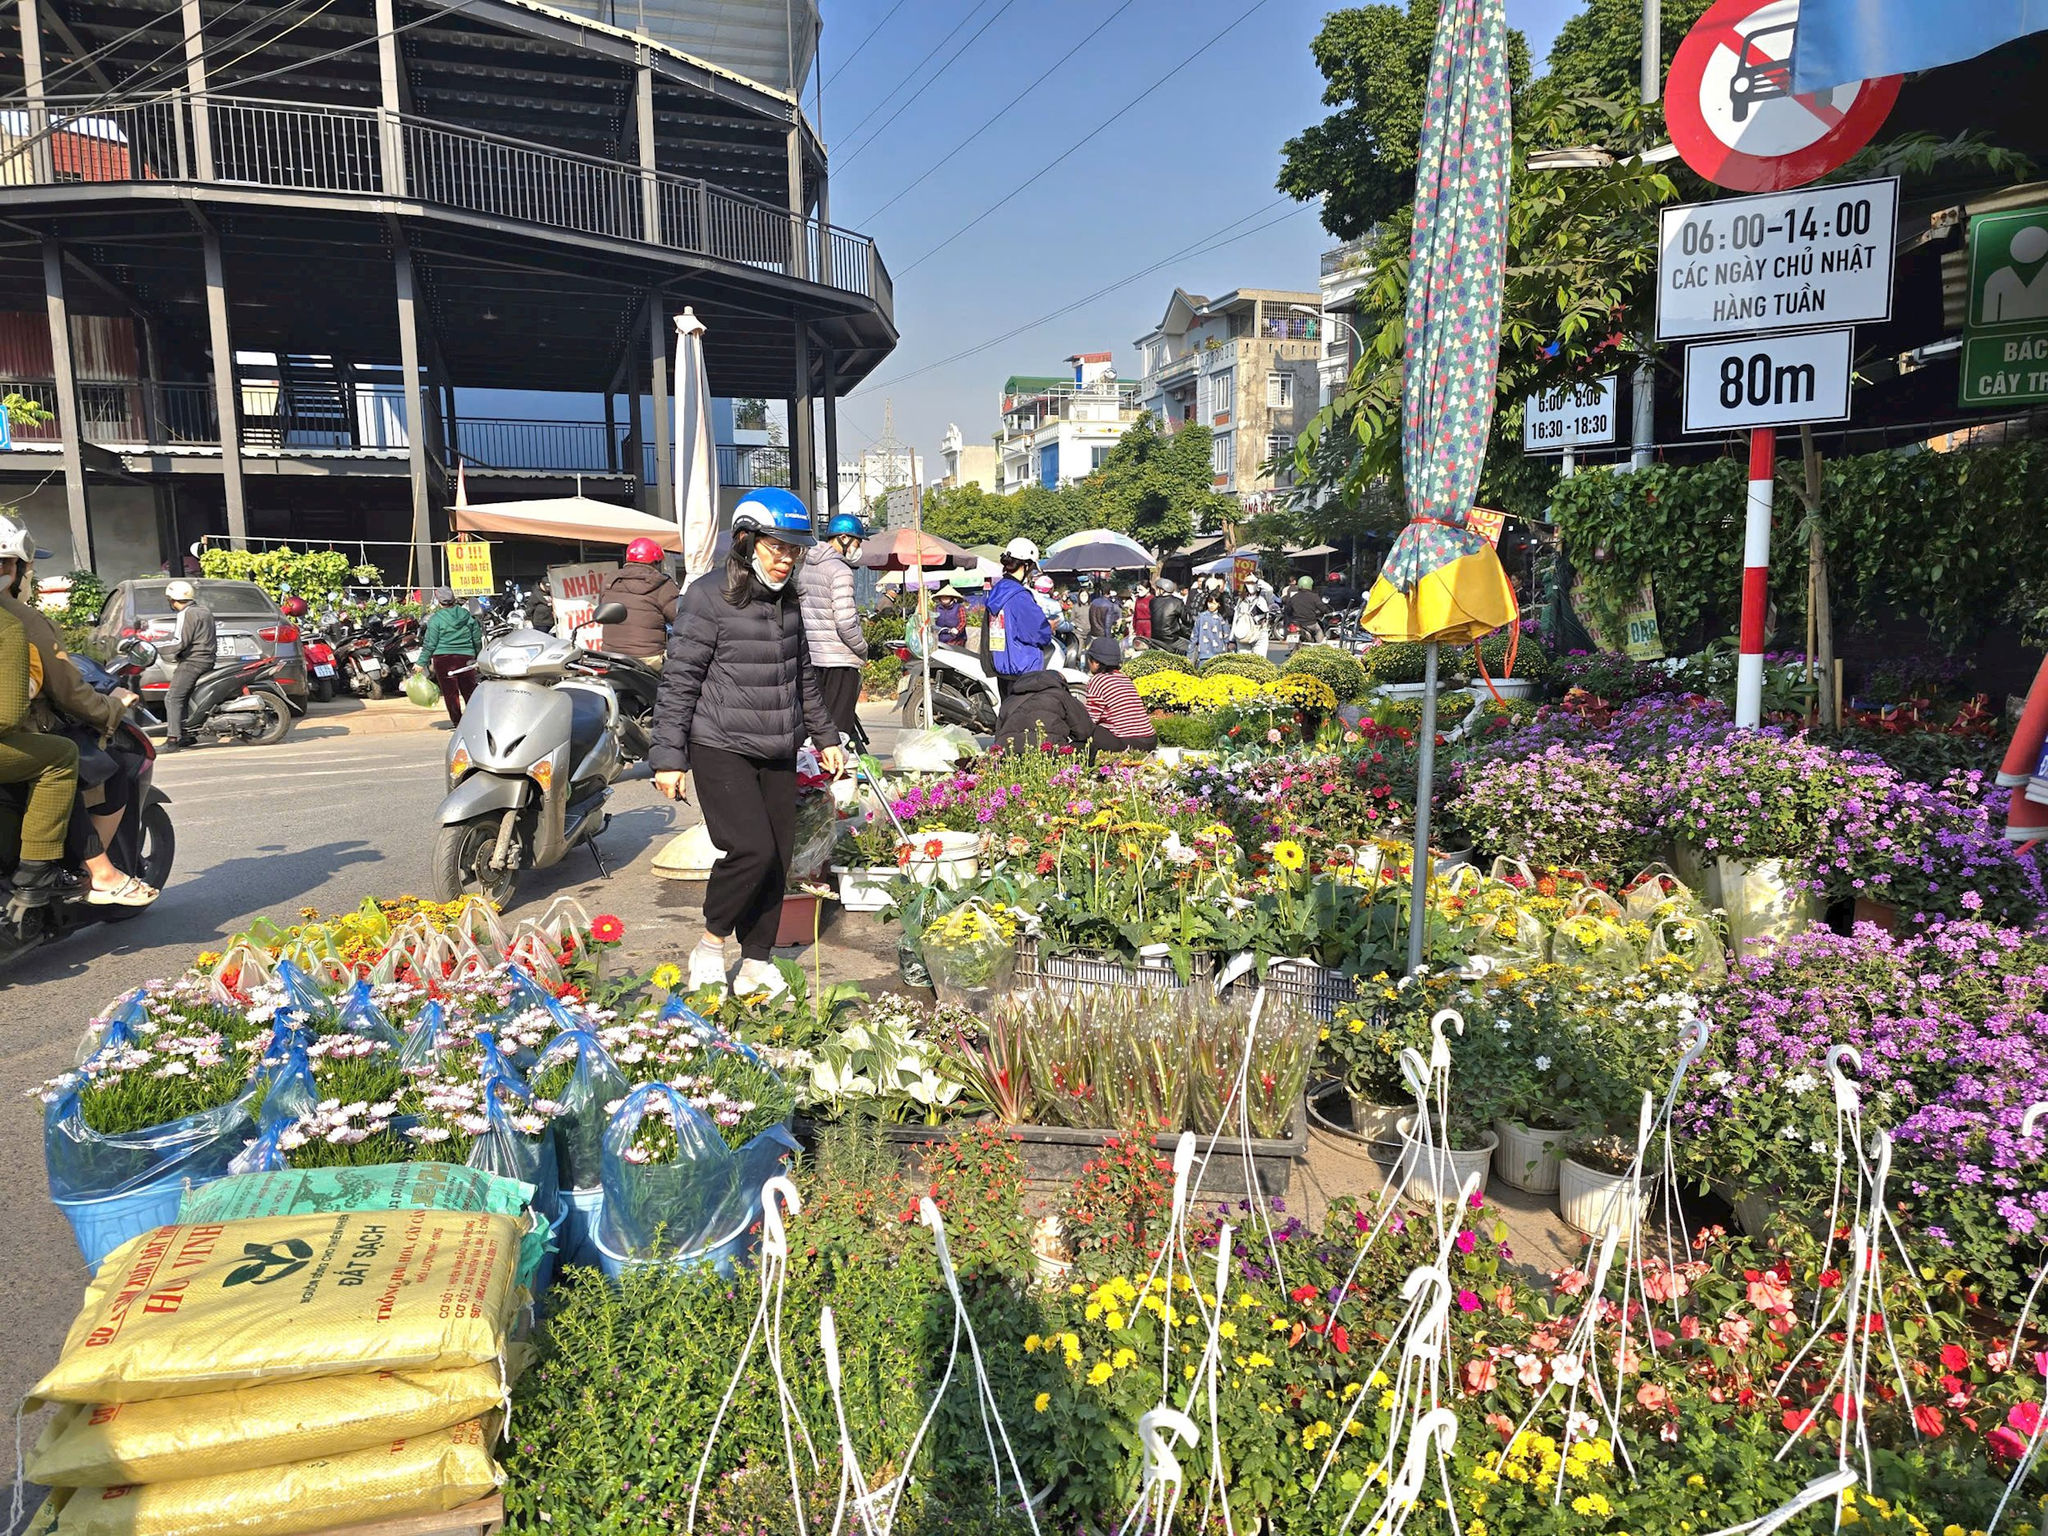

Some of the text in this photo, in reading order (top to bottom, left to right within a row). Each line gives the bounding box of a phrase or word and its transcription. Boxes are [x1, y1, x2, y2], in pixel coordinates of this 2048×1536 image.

[1672, 243, 1877, 290] CÁC NGÀY CHỦ NHẬT
[1713, 283, 1826, 322] HÀNG TUẦN
[1720, 353, 1815, 409] 80m
[1979, 370, 2022, 395] CÂY
[1531, 419, 1563, 440] 16:30
[1574, 414, 1607, 435] 18:30
[172, 1225, 226, 1269] VINH
[332, 1225, 388, 1287] ĐẤT SẠCH
